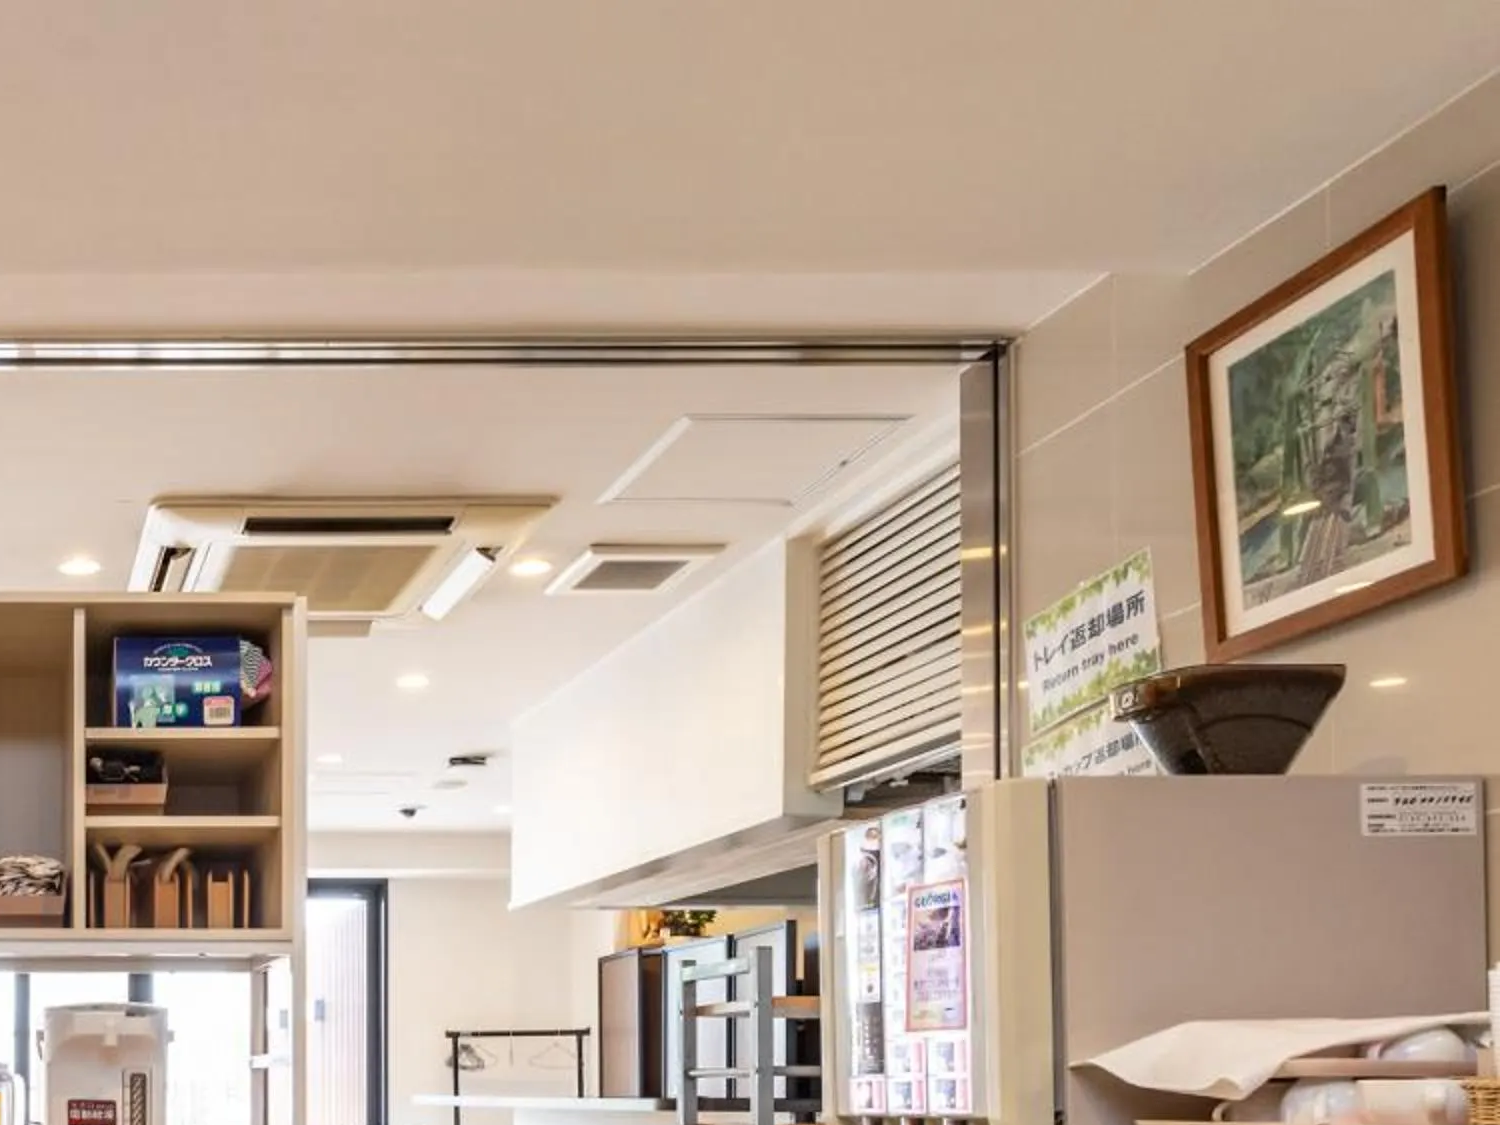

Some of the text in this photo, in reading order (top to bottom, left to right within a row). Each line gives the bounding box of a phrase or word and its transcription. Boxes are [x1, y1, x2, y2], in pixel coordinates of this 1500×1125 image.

[1033, 589, 1145, 672] トレイ返却場所
[1042, 633, 1139, 691] Return tray here
